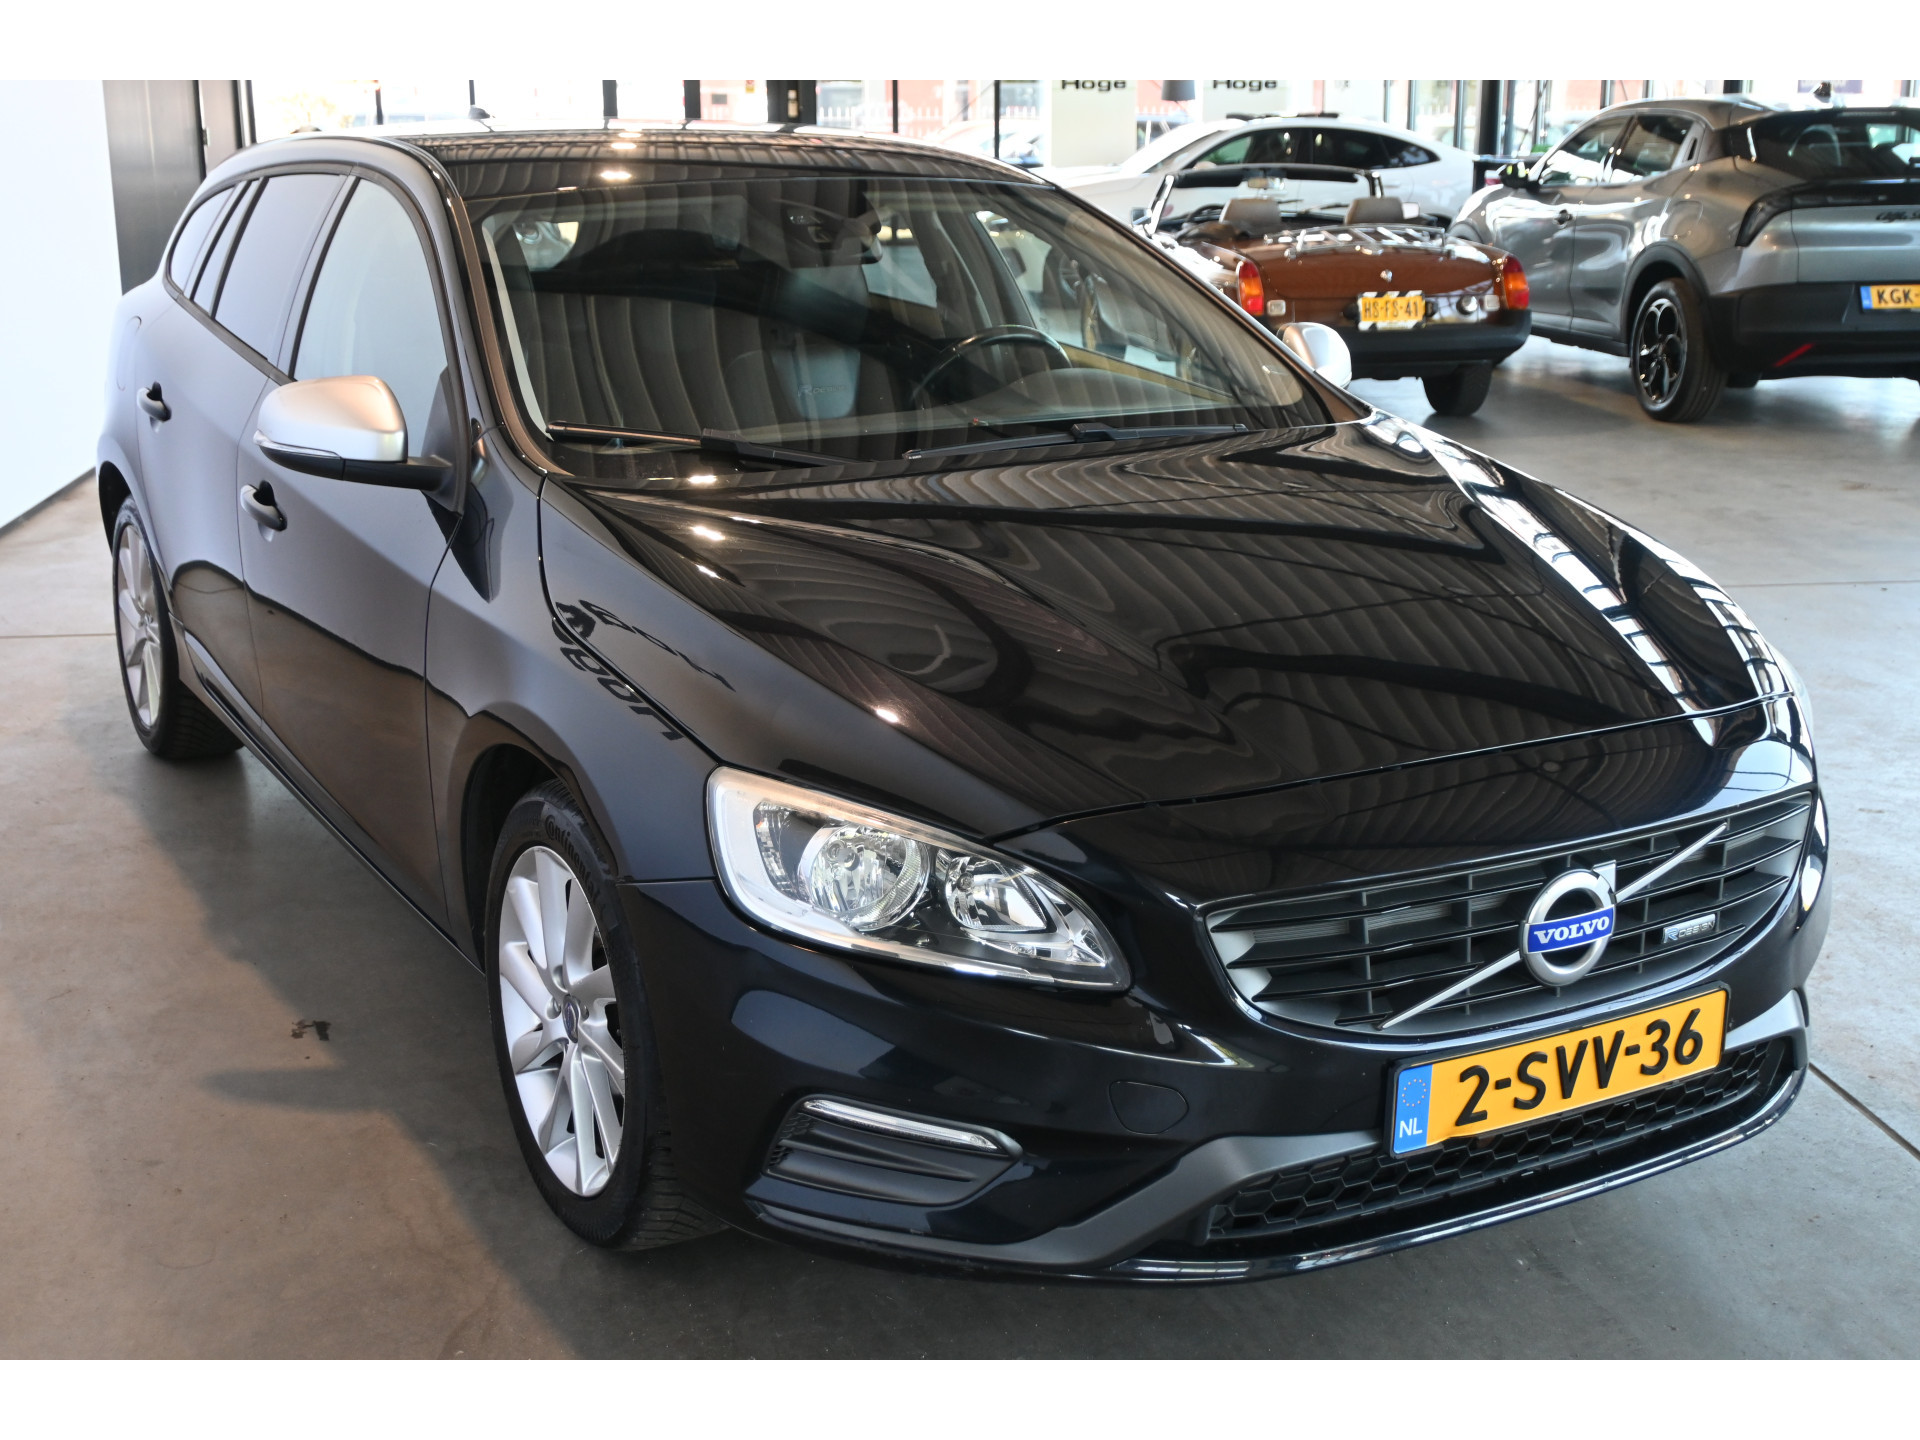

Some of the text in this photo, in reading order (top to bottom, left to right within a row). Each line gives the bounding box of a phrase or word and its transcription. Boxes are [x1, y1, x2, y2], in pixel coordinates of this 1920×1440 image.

[1534, 916, 1609, 944] VOLVO
[1456, 1008, 1703, 1126] 2-SVV-36
[1399, 1117, 1423, 1138] NL
